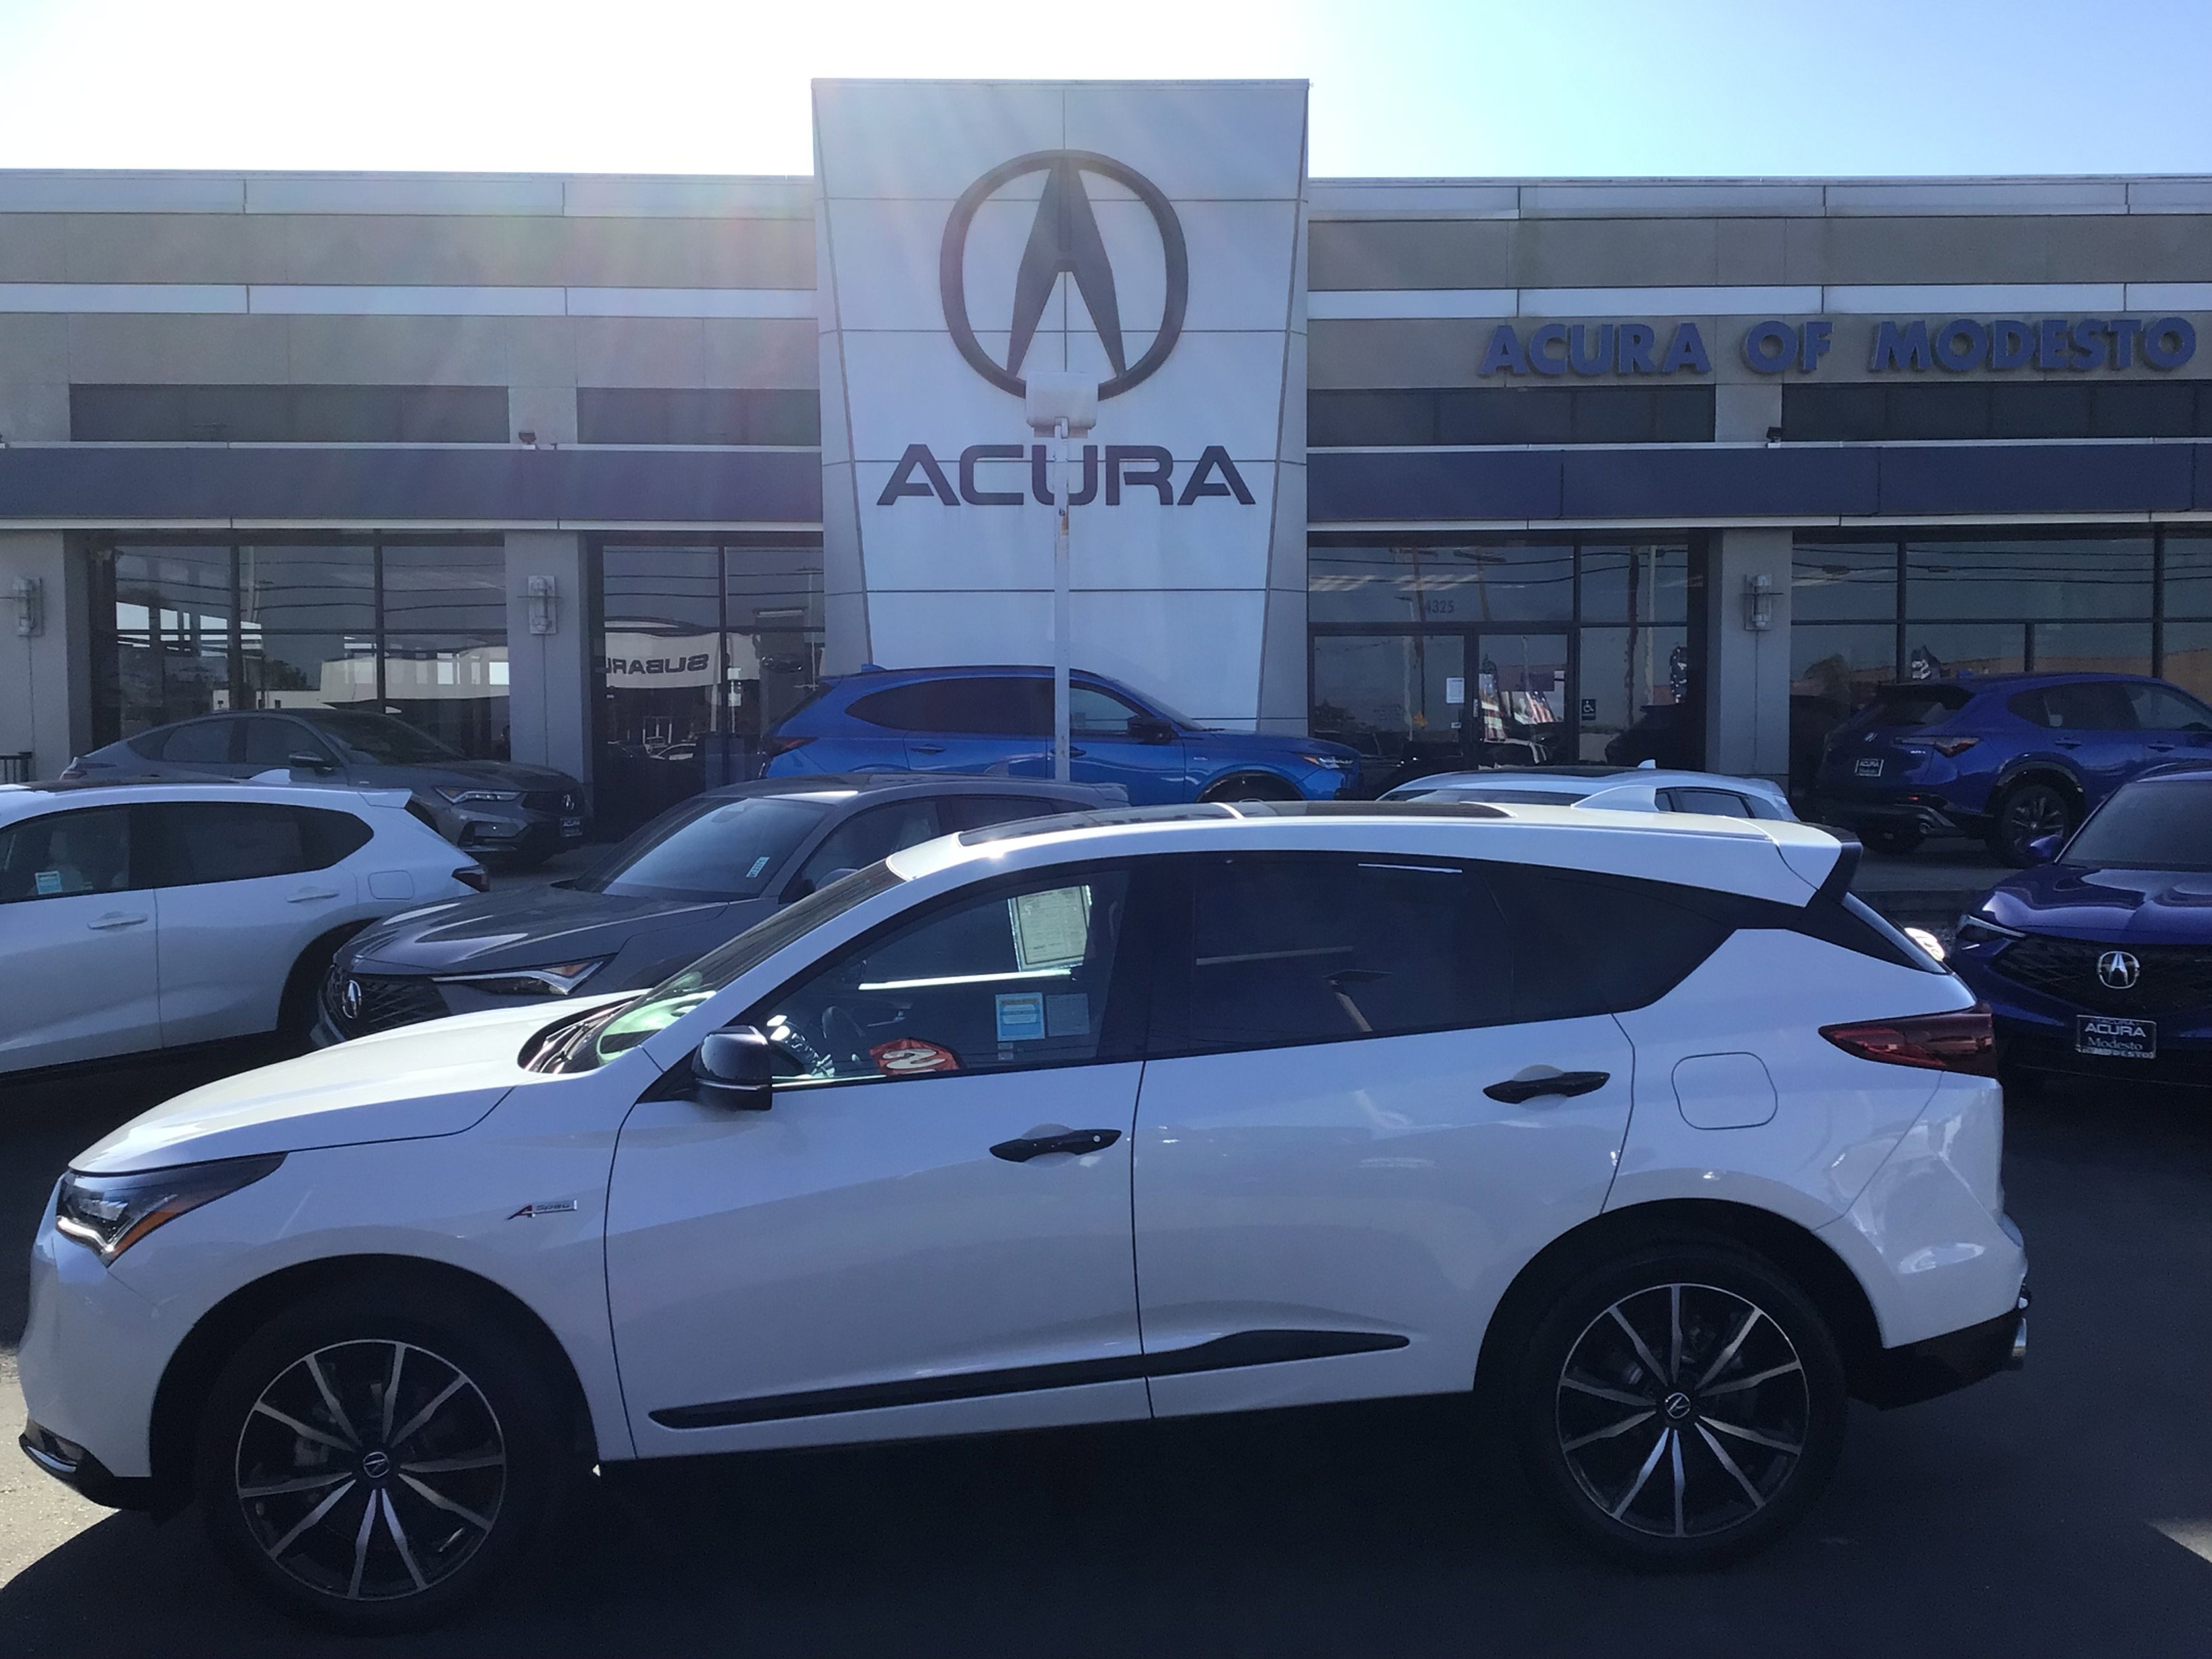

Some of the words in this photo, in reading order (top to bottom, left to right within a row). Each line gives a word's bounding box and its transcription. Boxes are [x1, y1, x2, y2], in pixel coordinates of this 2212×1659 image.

[1479, 323, 1713, 375] ACURA
[1746, 321, 1833, 373] OF
[1872, 316, 2198, 371] MODESTO
[876, 444, 1256, 506] ACURA
[1425, 599, 1454, 614] 4325
[2085, 1023, 2147, 1038] ACURA
[2087, 1037, 2143, 1051] Modesto
